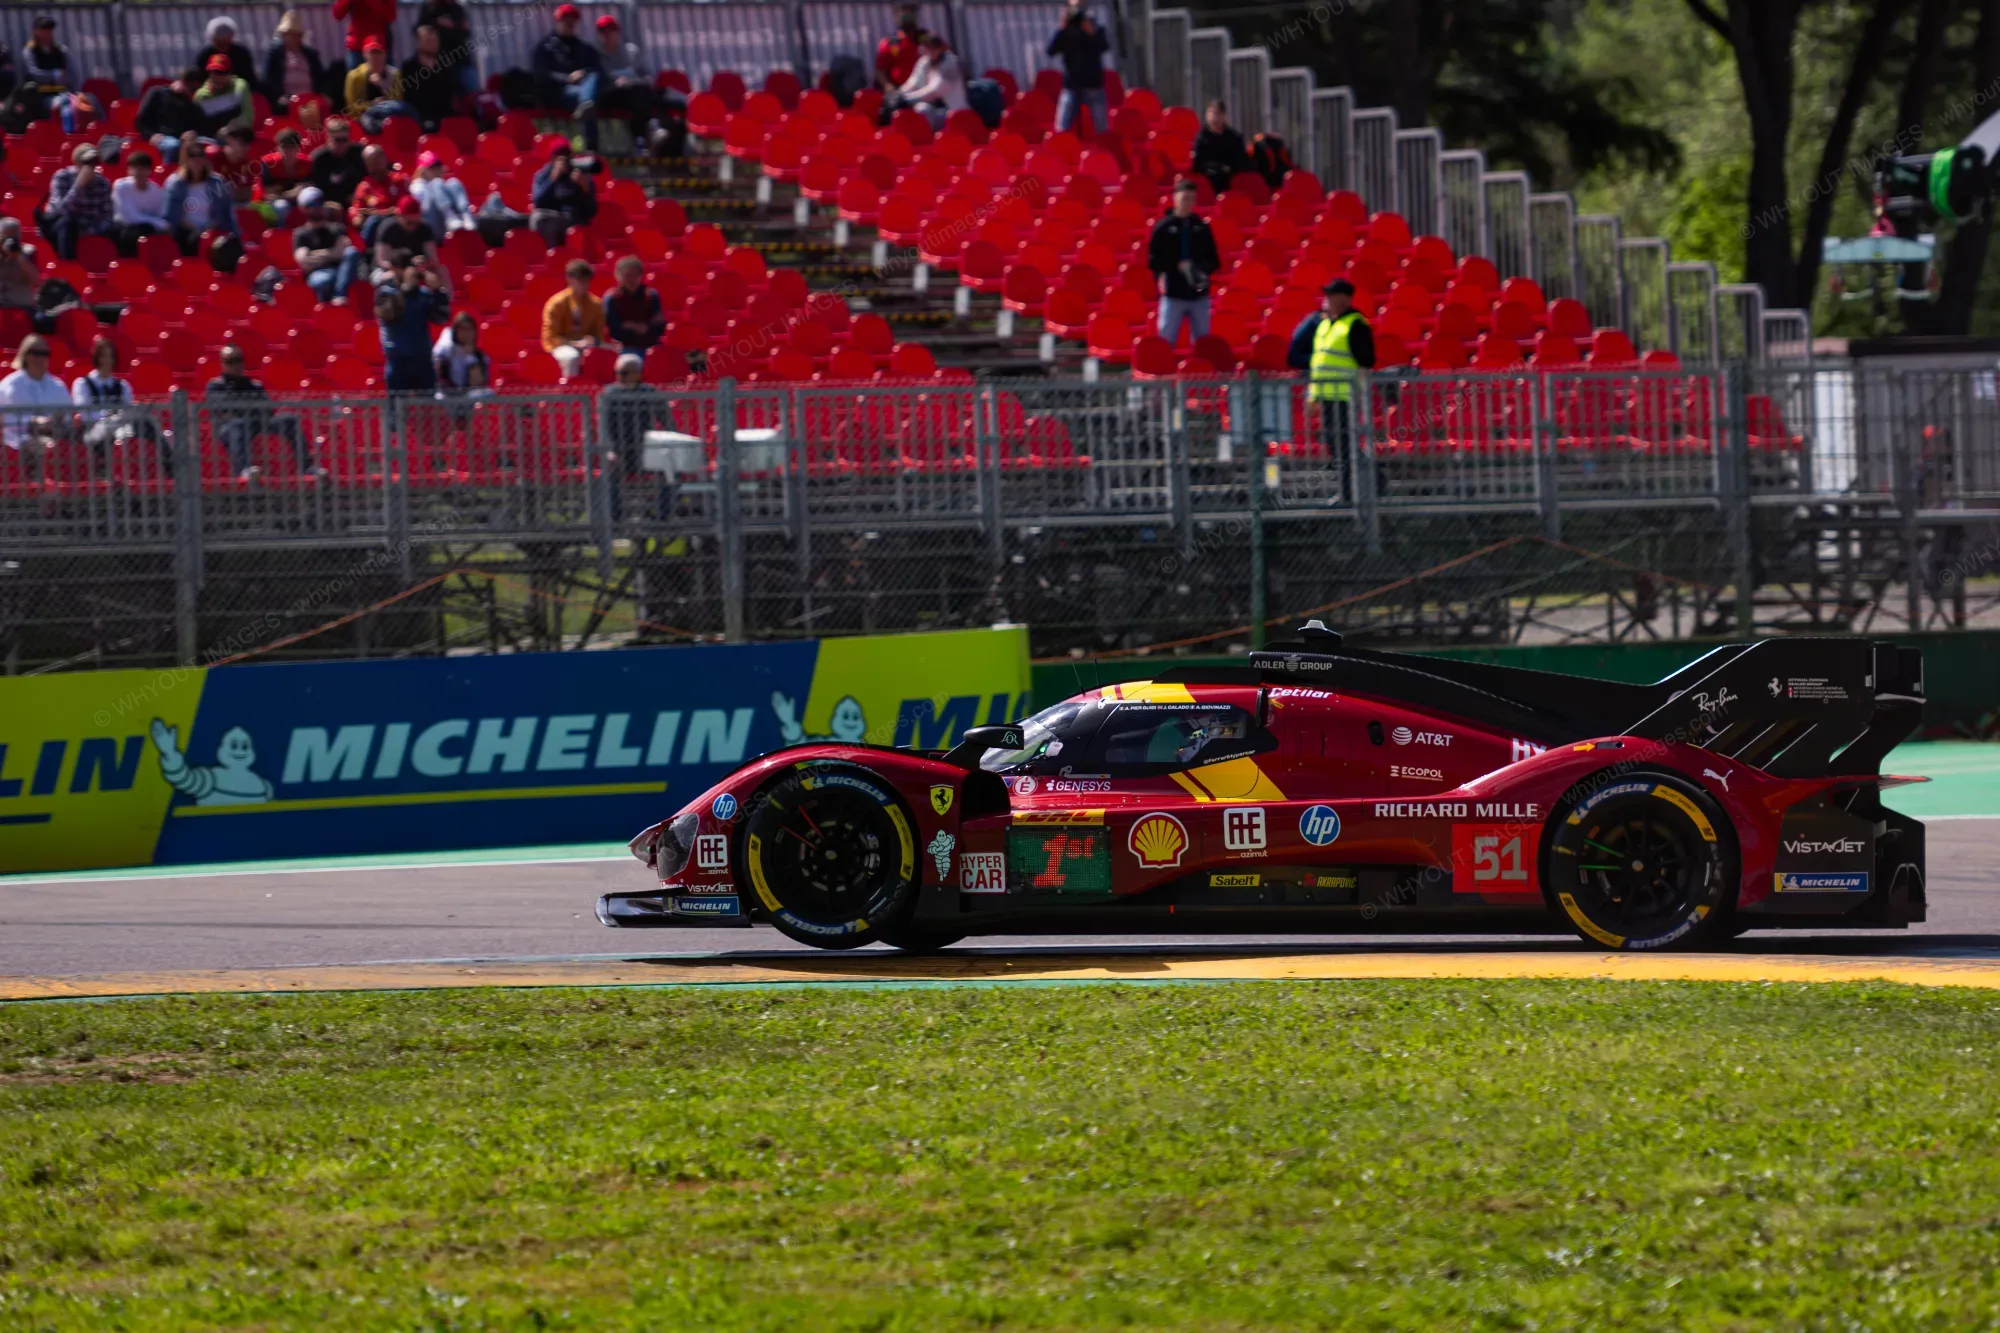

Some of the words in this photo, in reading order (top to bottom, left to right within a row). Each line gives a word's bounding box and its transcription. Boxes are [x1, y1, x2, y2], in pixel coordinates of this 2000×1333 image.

[1253, 661, 1285, 670] ADLER
[1300, 661, 1333, 671] GROUP
[1268, 687, 1333, 699] Cetilar
[1692, 687, 1738, 711] Ray-Ban
[281, 708, 754, 784] MICHELIN
[1415, 733, 1453, 747] AT&T
[0, 735, 145, 796] IN
[1402, 767, 1443, 778] ECOPOL
[826, 776, 887, 801] MICHELIN
[1056, 780, 1111, 792] GENESYS
[1587, 783, 1650, 806] MICHELIN
[715, 795, 733, 819] hp
[1375, 803, 1467, 817] RICHARD
[1476, 803, 1538, 817] MILLE
[1306, 806, 1335, 845] hp
[1033, 832, 1096, 887] 1st
[1240, 849, 1268, 858] azimut
[1474, 836, 1528, 880] 51
[960, 856, 1002, 868] HYPER
[708, 867, 728, 875] azimut
[962, 869, 1002, 889] CAR
[1215, 875, 1255, 886] Sabelt
[1801, 878, 1860, 886] MICHELIN
[681, 902, 731, 910] MICHELIN
